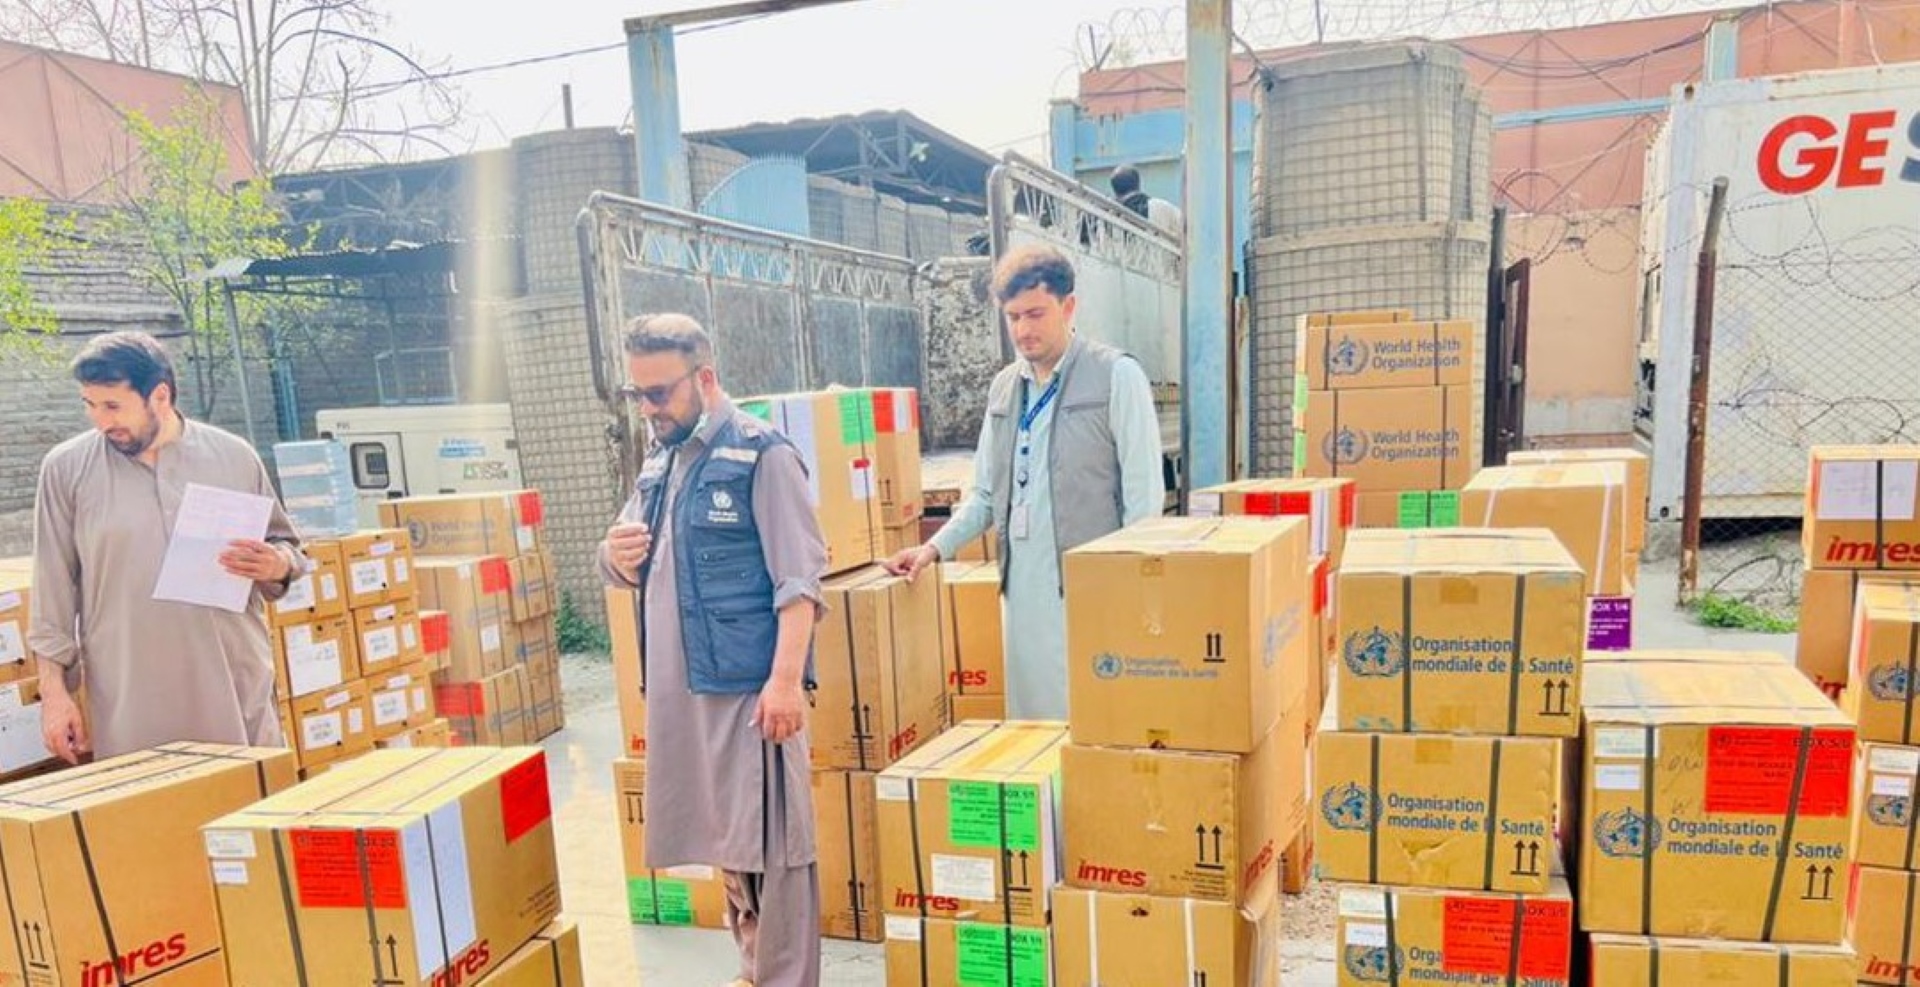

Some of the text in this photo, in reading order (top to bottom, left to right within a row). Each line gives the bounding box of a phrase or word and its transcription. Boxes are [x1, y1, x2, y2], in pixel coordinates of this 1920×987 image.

[1373, 338, 1412, 353] World
[1372, 356, 1460, 373] Organizaion
[1373, 428, 1460, 445] World Heath
[1592, 602, 1610, 611] OX
[1412, 636, 1517, 656] Organisation
[1412, 656, 1483, 672] mondiale
[1487, 656, 1506, 672] de
[1528, 655, 1574, 674] Santé
[1388, 792, 1485, 812] Organisation
[1387, 812, 1457, 831] mondiale
[1460, 815, 1480, 832] de
[1501, 818, 1545, 836] Santé
[1668, 816, 1777, 838] Organisation
[1667, 838, 1745, 856] mondiale
[1749, 840, 1769, 857] de
[1794, 841, 1844, 859] Santé
[1077, 859, 1147, 888] imres
[894, 886, 960, 912] imres
[80, 932, 187, 987] imres
